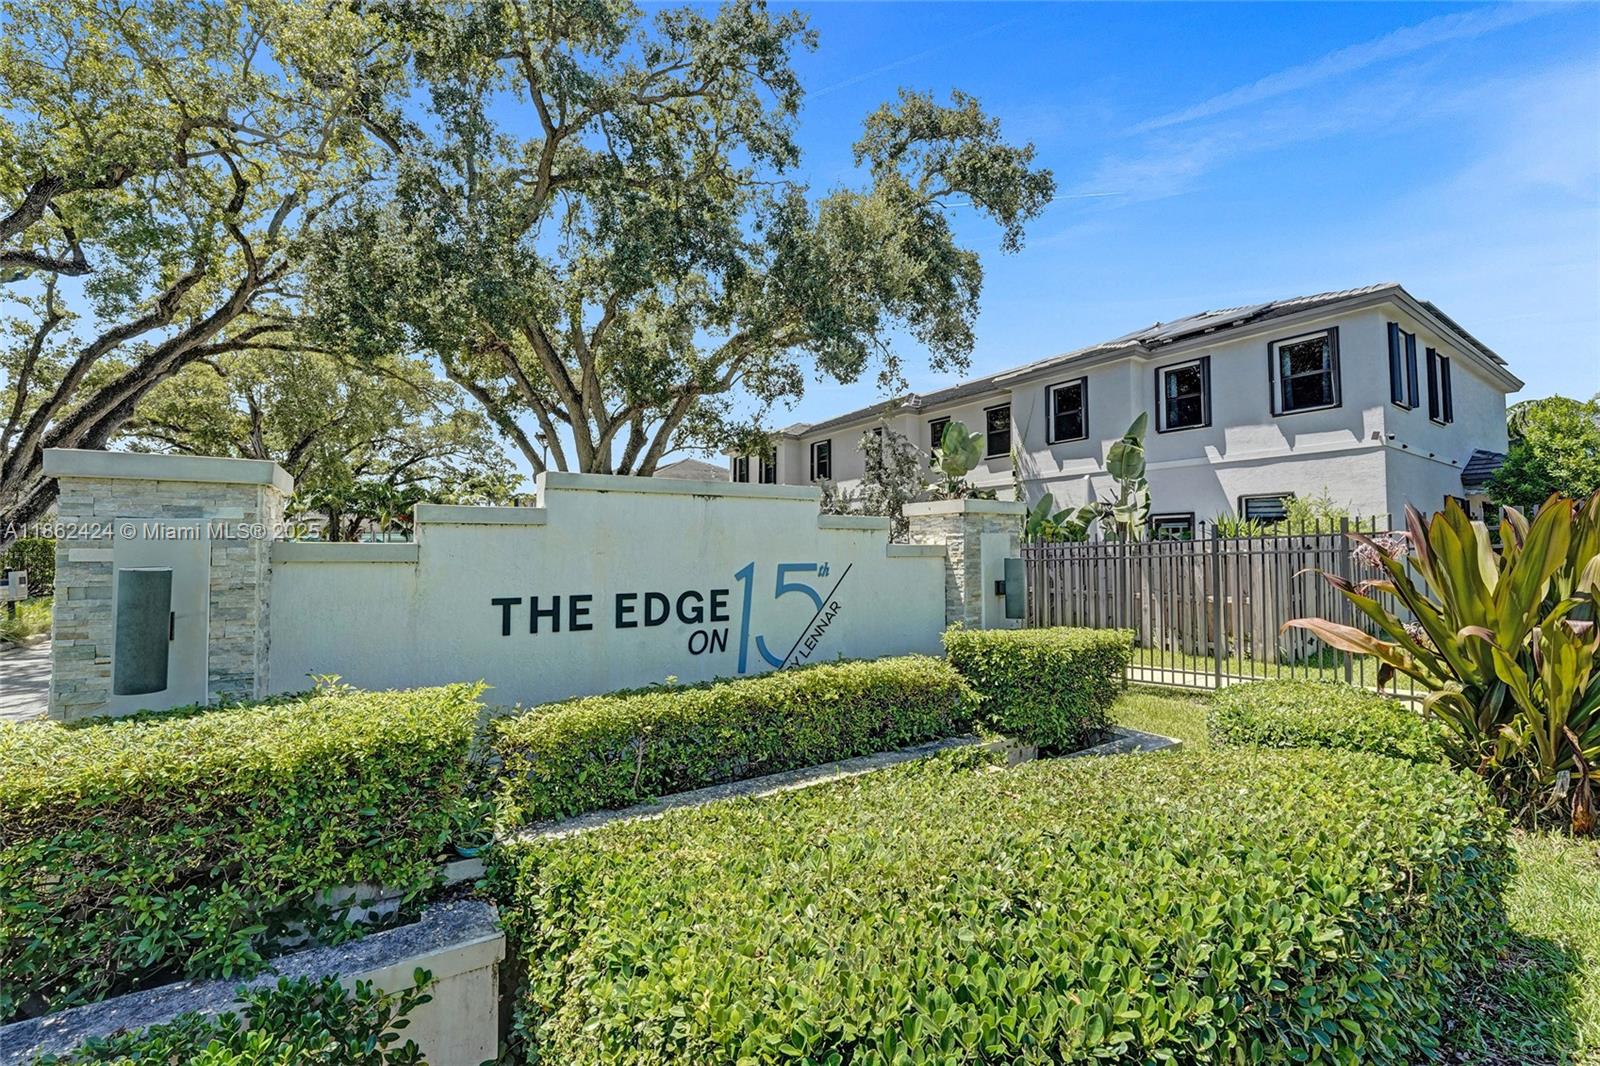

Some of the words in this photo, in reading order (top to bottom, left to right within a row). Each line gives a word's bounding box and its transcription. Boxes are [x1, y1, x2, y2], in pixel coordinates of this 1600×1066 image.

[491, 594, 594, 637] THE
[614, 588, 731, 630] EDGE
[799, 600, 842, 659] LENNAR
[687, 627, 729, 656] ON
